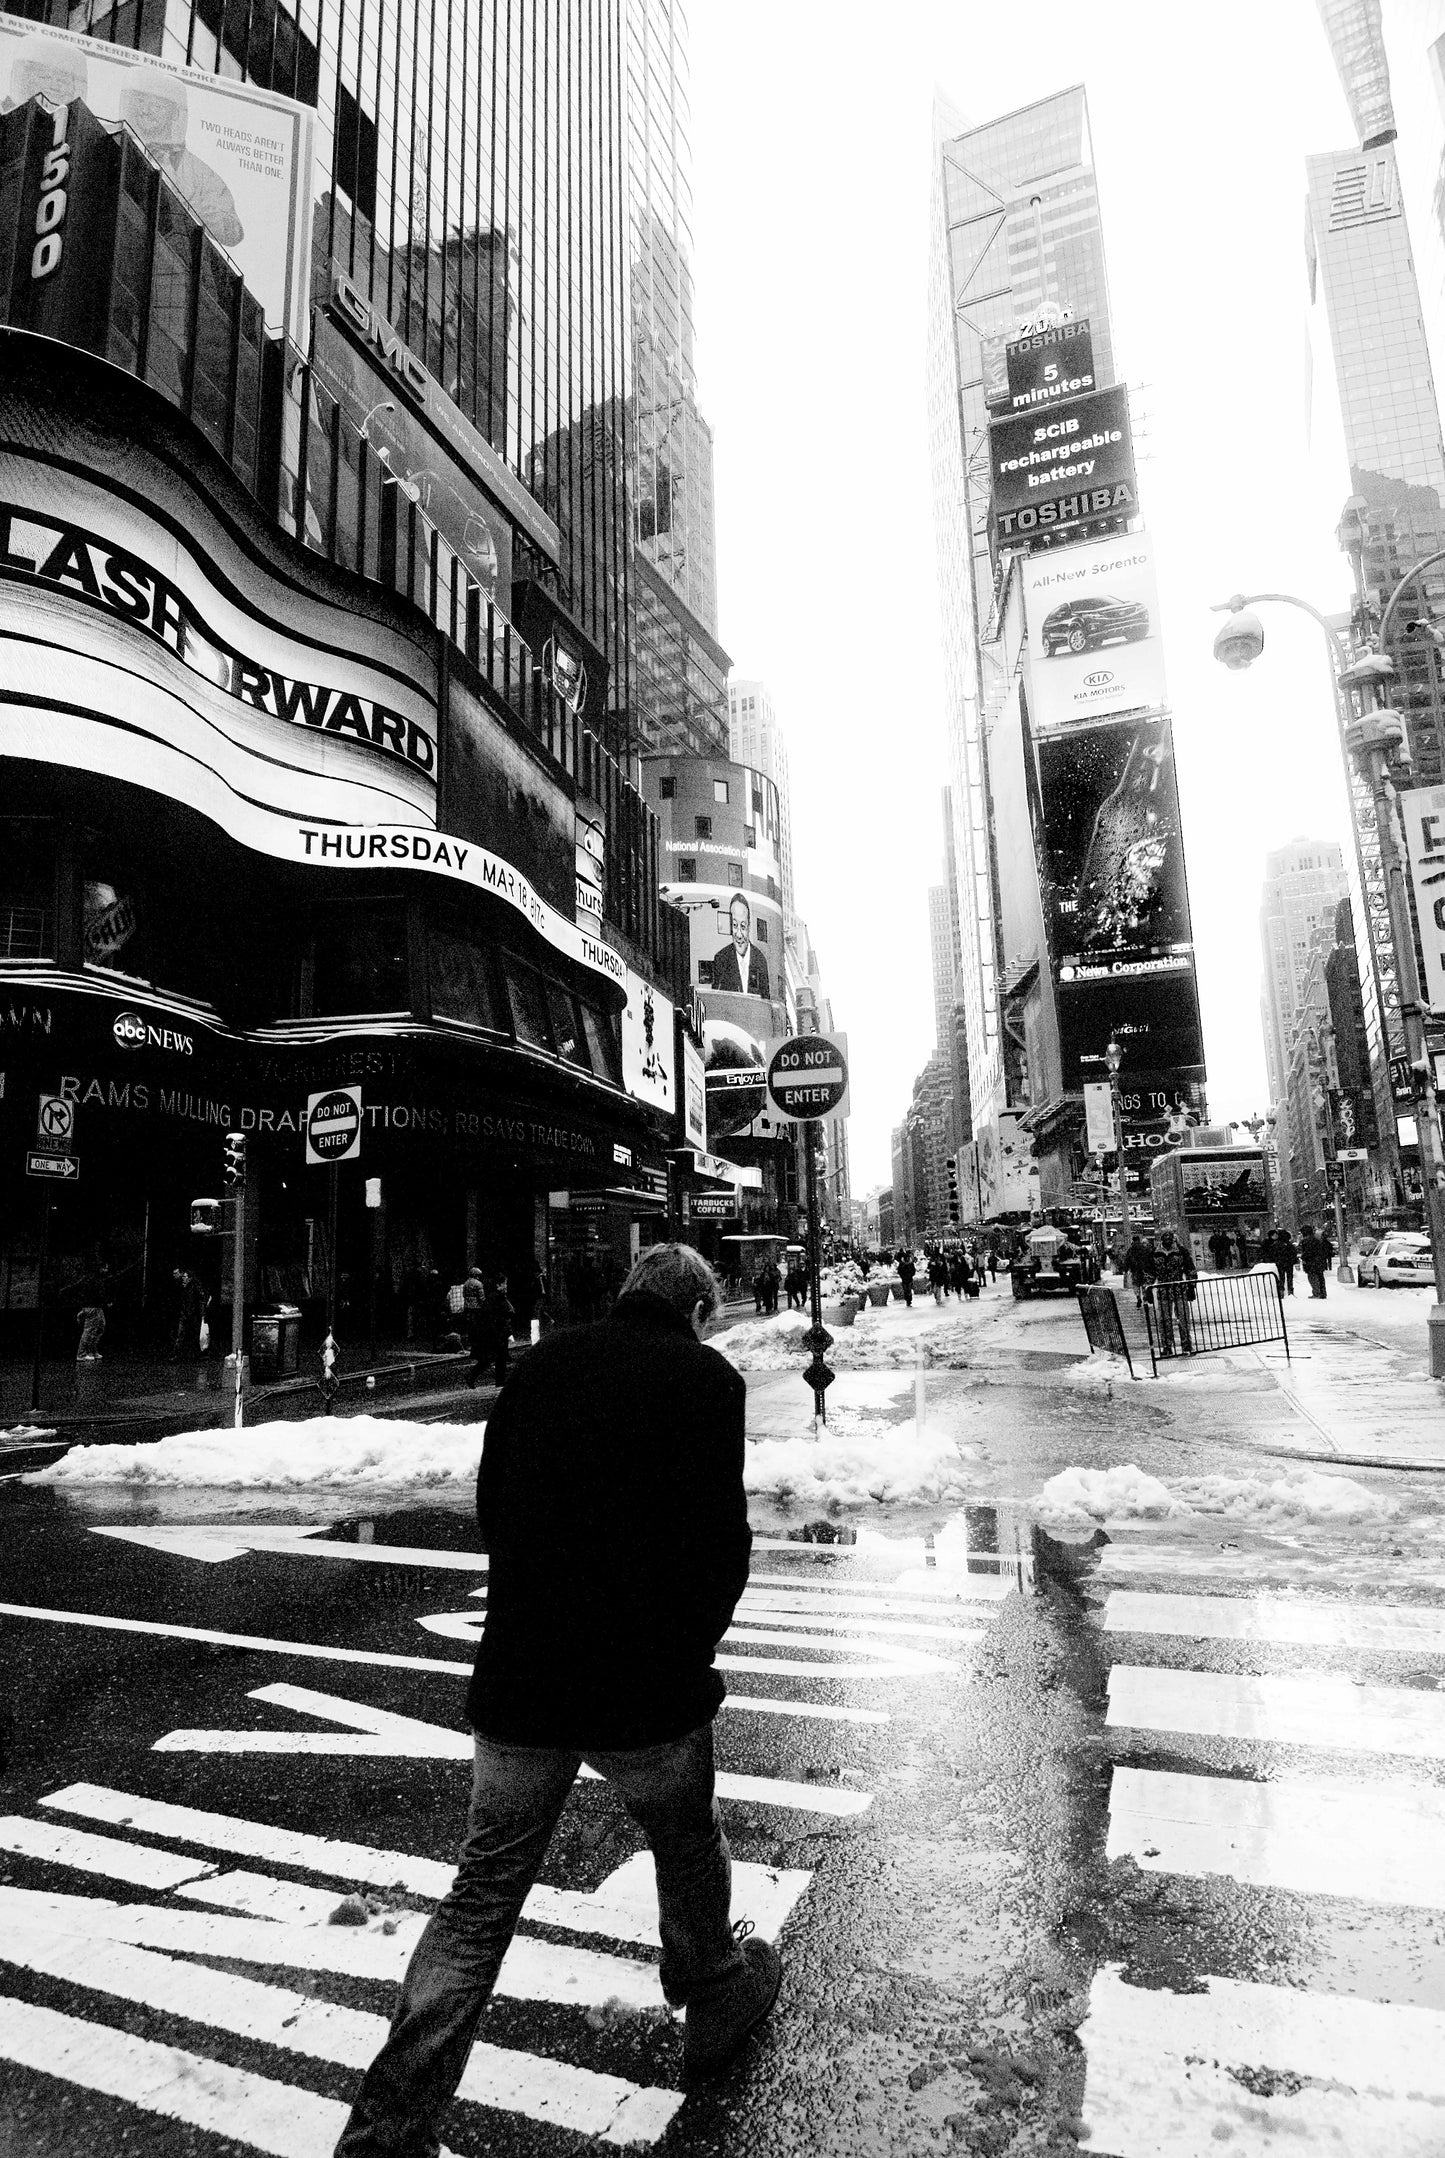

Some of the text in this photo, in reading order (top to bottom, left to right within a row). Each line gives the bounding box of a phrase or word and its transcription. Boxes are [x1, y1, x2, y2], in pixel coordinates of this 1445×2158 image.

[8, 19, 38, 33] NEW
[40, 29, 93, 49] COMEDY
[95, 43, 140, 62] SERIES
[143, 57, 178, 74] FROM
[181, 68, 218, 85] SPIKE
[200, 119, 285, 152] TWO HEADS AREN'T
[216, 139, 285, 166] ALWAYS BETTER
[238, 158, 285, 180] THAN ONE.
[31, 104, 71, 279] 1500
[337, 275, 428, 403] GMC
[1007, 323, 1089, 356] TOSHIBA
[1043, 364, 1058, 382] 5
[1013, 374, 1093, 407] minutes
[1000, 430, 1122, 473] rechargeable
[1028, 460, 1096, 488] battery
[999, 484, 1135, 534] TOSHIBA
[1032, 554, 1147, 590] All-New Sorento
[1088, 673, 1110, 685] KIA
[1073, 690, 1088, 701] KIA
[1090, 684, 1126, 698] MOTORS
[665, 841, 699, 852] National
[700, 842, 741, 857] Association
[298, 827, 469, 872] THURSDAY
[482, 858, 515, 898] MAR
[517, 880, 529, 909] 18
[1058, 900, 1079, 913] THE
[1075, 955, 1189, 979] News Corporation
[113, 1018, 194, 1056] abc NEWS
[781, 1050, 832, 1068] DO NOT
[726, 1073, 755, 1085] Enjoy
[785, 1088, 830, 1106] ENTER
[1148, 1092, 1167, 1109] TO
[59, 1075, 150, 1109] RAMS
[160, 1088, 232, 1128] MULLING
[240, 1107, 309, 1132] DRAF
[482, 1115, 526, 1142] SAYS
[529, 1122, 569, 1149] TRADE
[317, 1102, 352, 1118] DO NOT
[318, 1133, 348, 1149] ENTER
[34, 1160, 72, 1173] ONE WAY
[697, 1206, 727, 1214] COFFEE
